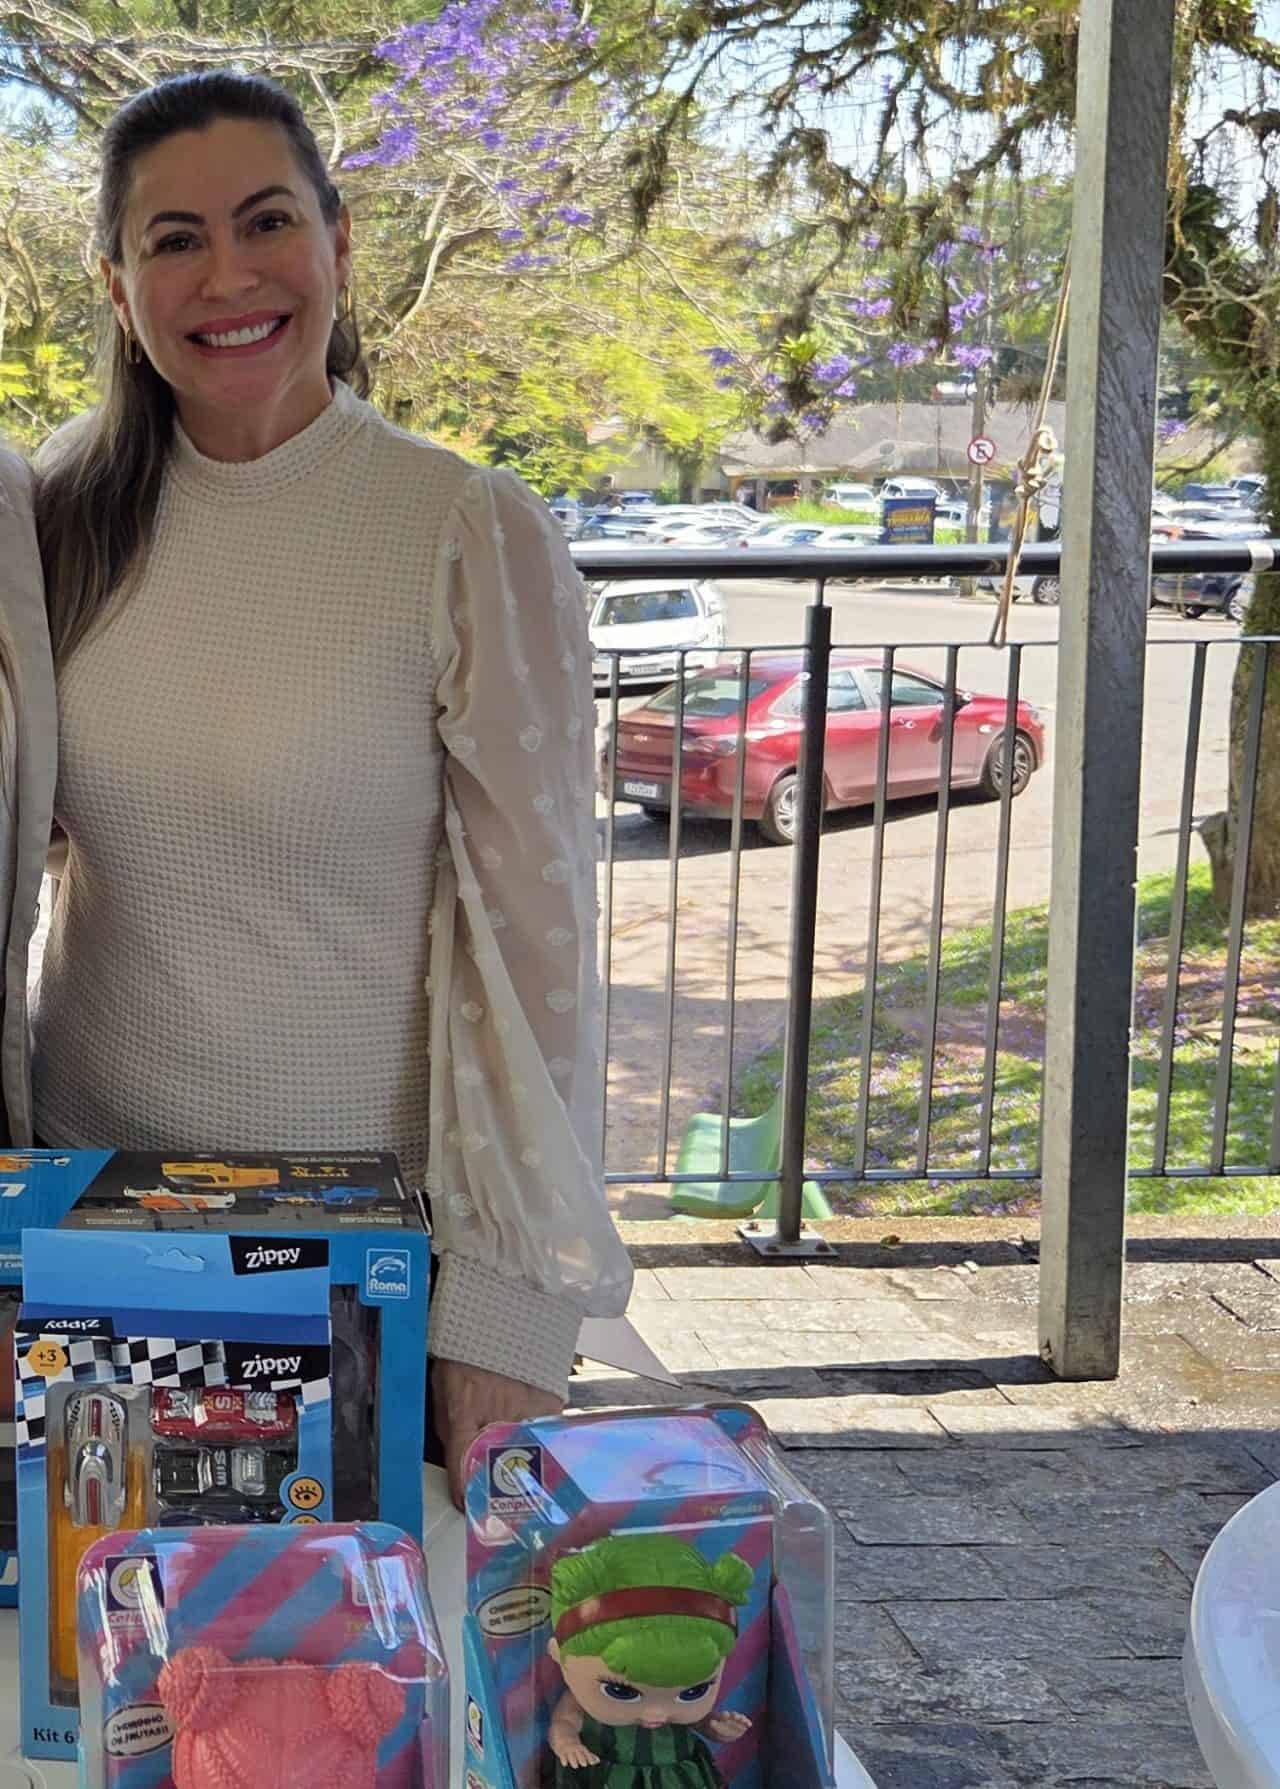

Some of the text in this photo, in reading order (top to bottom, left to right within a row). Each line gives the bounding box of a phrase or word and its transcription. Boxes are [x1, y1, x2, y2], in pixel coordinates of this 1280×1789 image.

[370, 1279, 407, 1293] Roma
[33, 1728, 74, 1744] Kit 6
